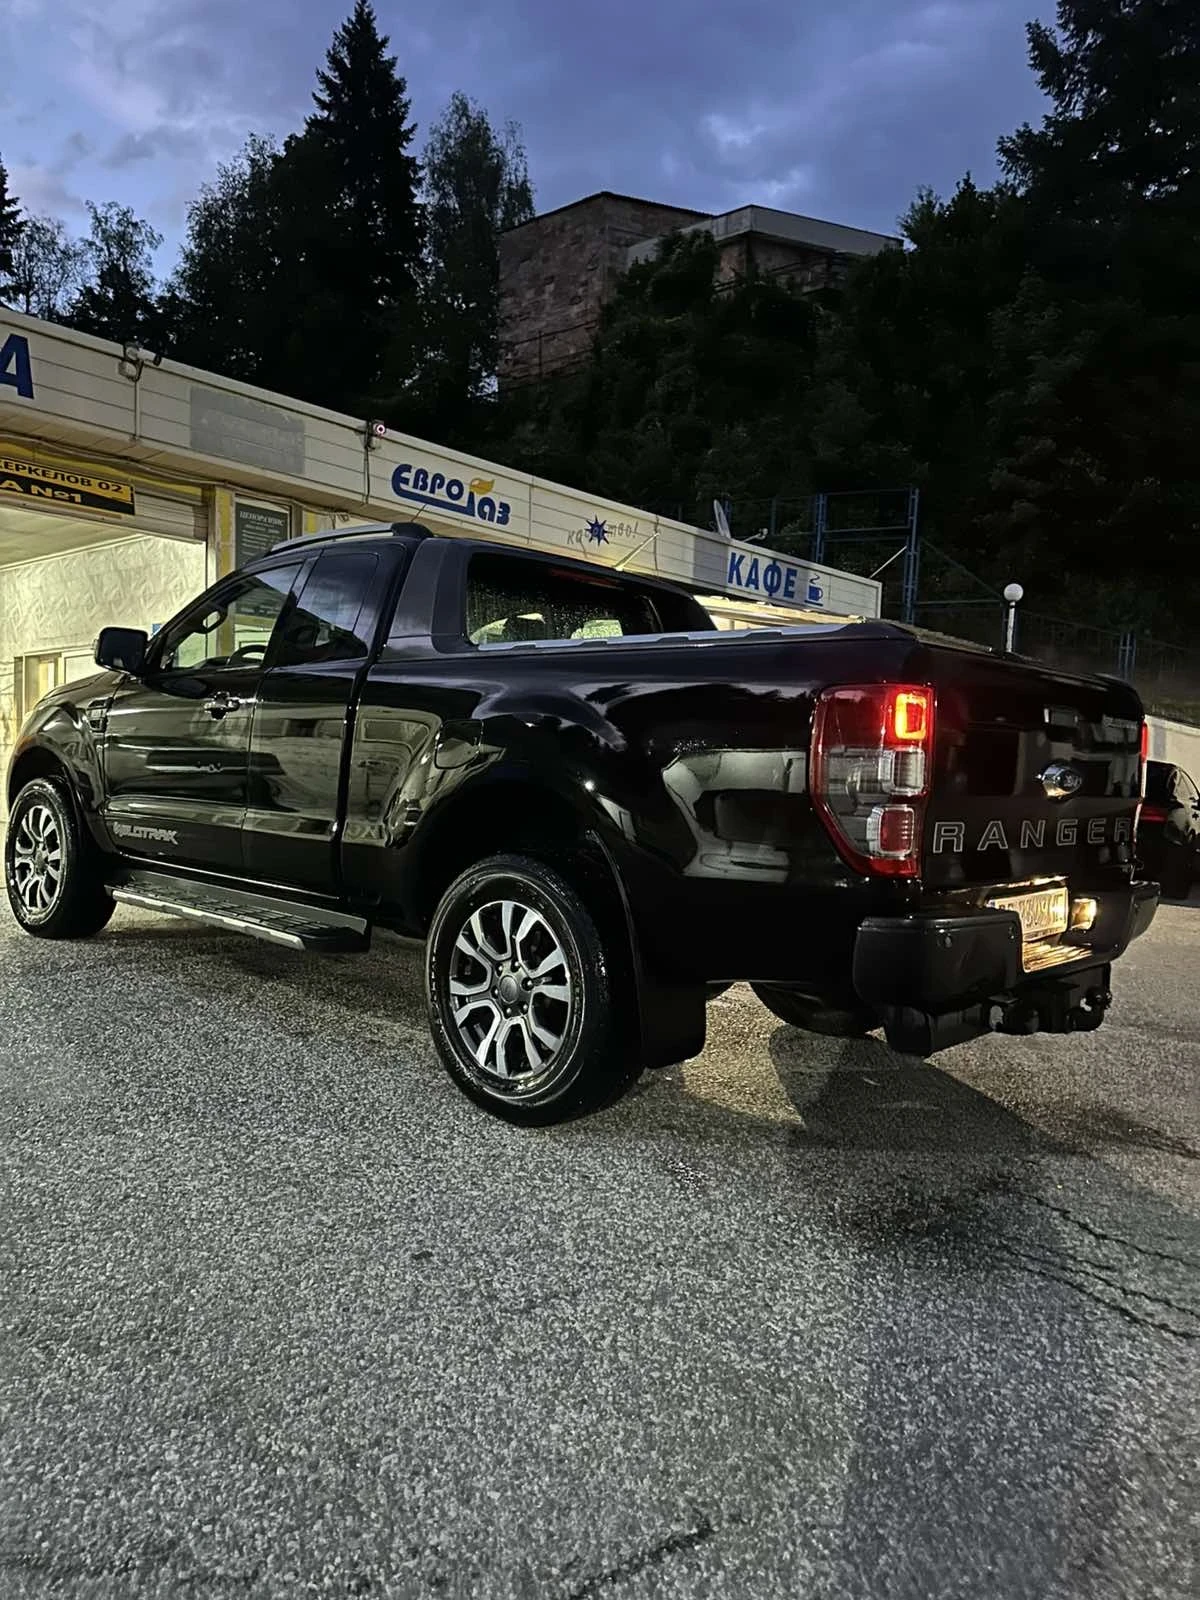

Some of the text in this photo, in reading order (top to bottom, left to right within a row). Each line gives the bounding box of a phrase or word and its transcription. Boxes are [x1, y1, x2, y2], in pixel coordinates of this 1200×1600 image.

[0, 460, 123, 494] ЕРКЕЛОВ 02
[727, 551, 798, 598] КАФЕ
[932, 816, 1132, 854] RANGER
